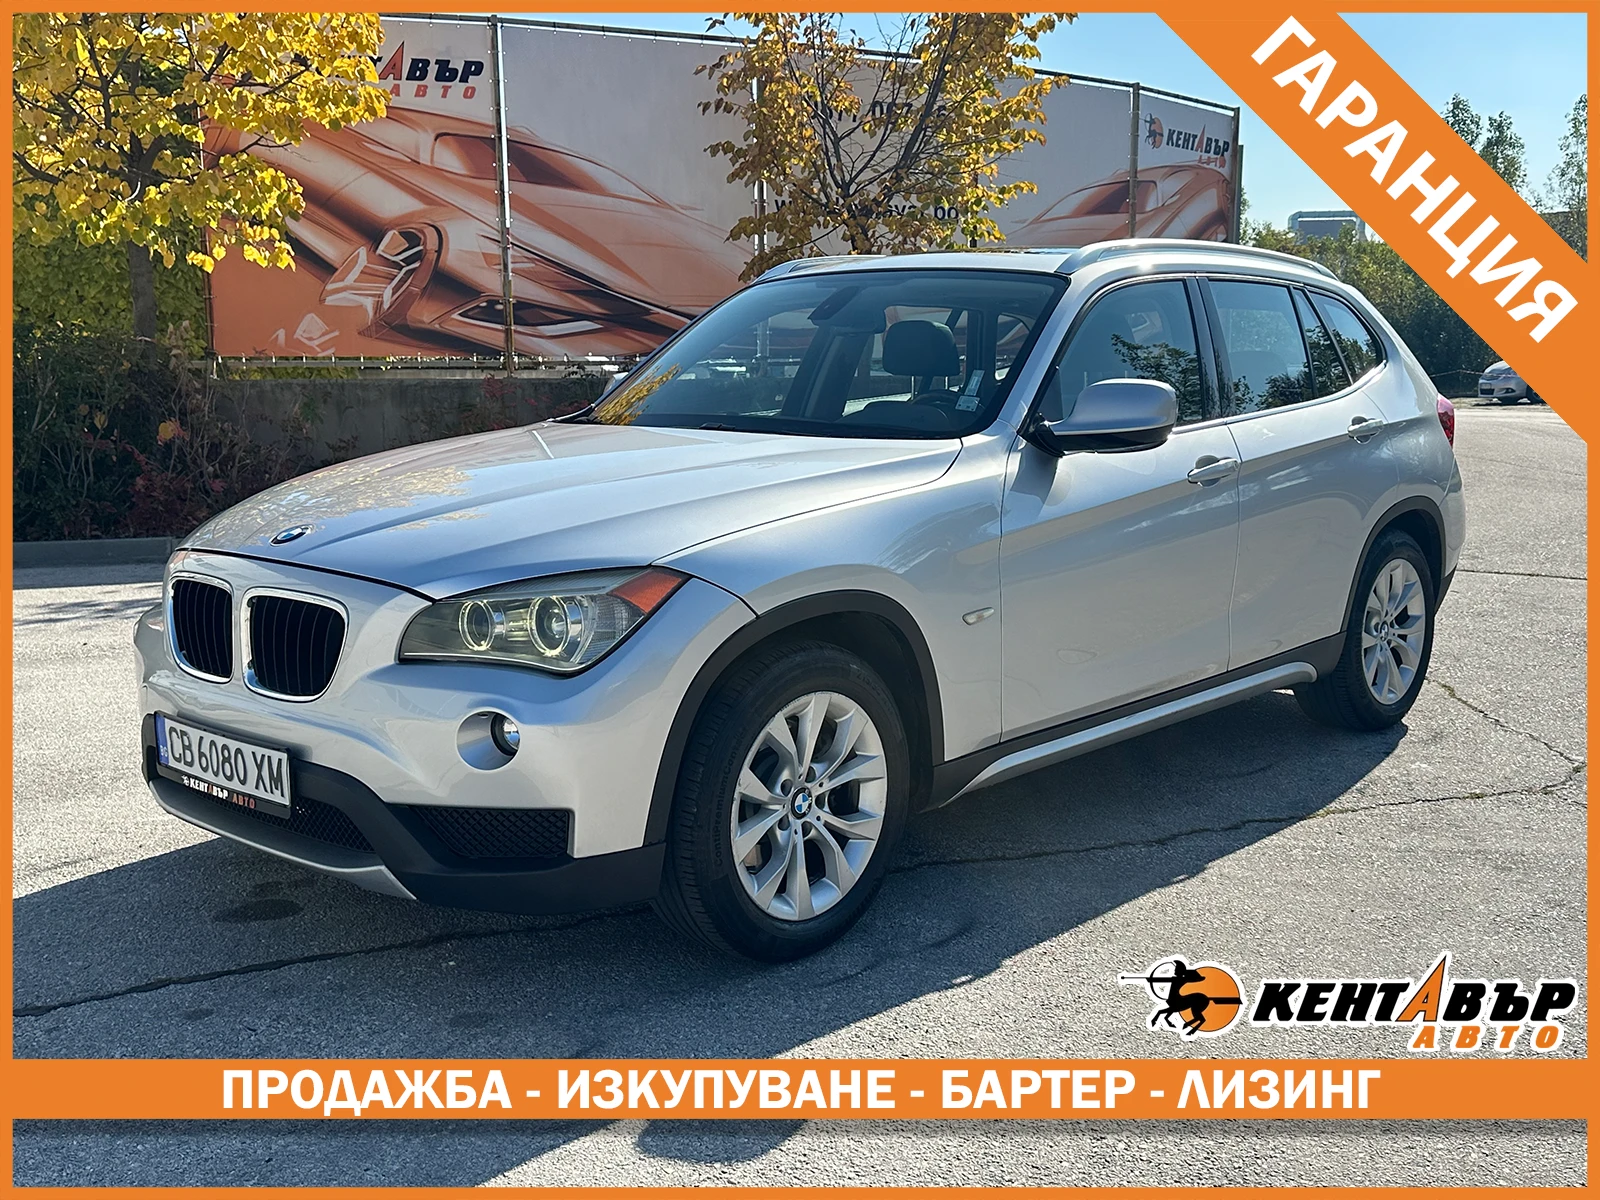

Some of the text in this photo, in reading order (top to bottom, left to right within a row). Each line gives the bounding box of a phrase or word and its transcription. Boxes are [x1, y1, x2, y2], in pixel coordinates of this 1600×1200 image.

[1166, 123, 1230, 157] КЕНТАВЪР
[198, 736, 248, 786] 6080
[251, 751, 286, 799] XM
[189, 778, 256, 809] КЕНТАВЪР АВТО
